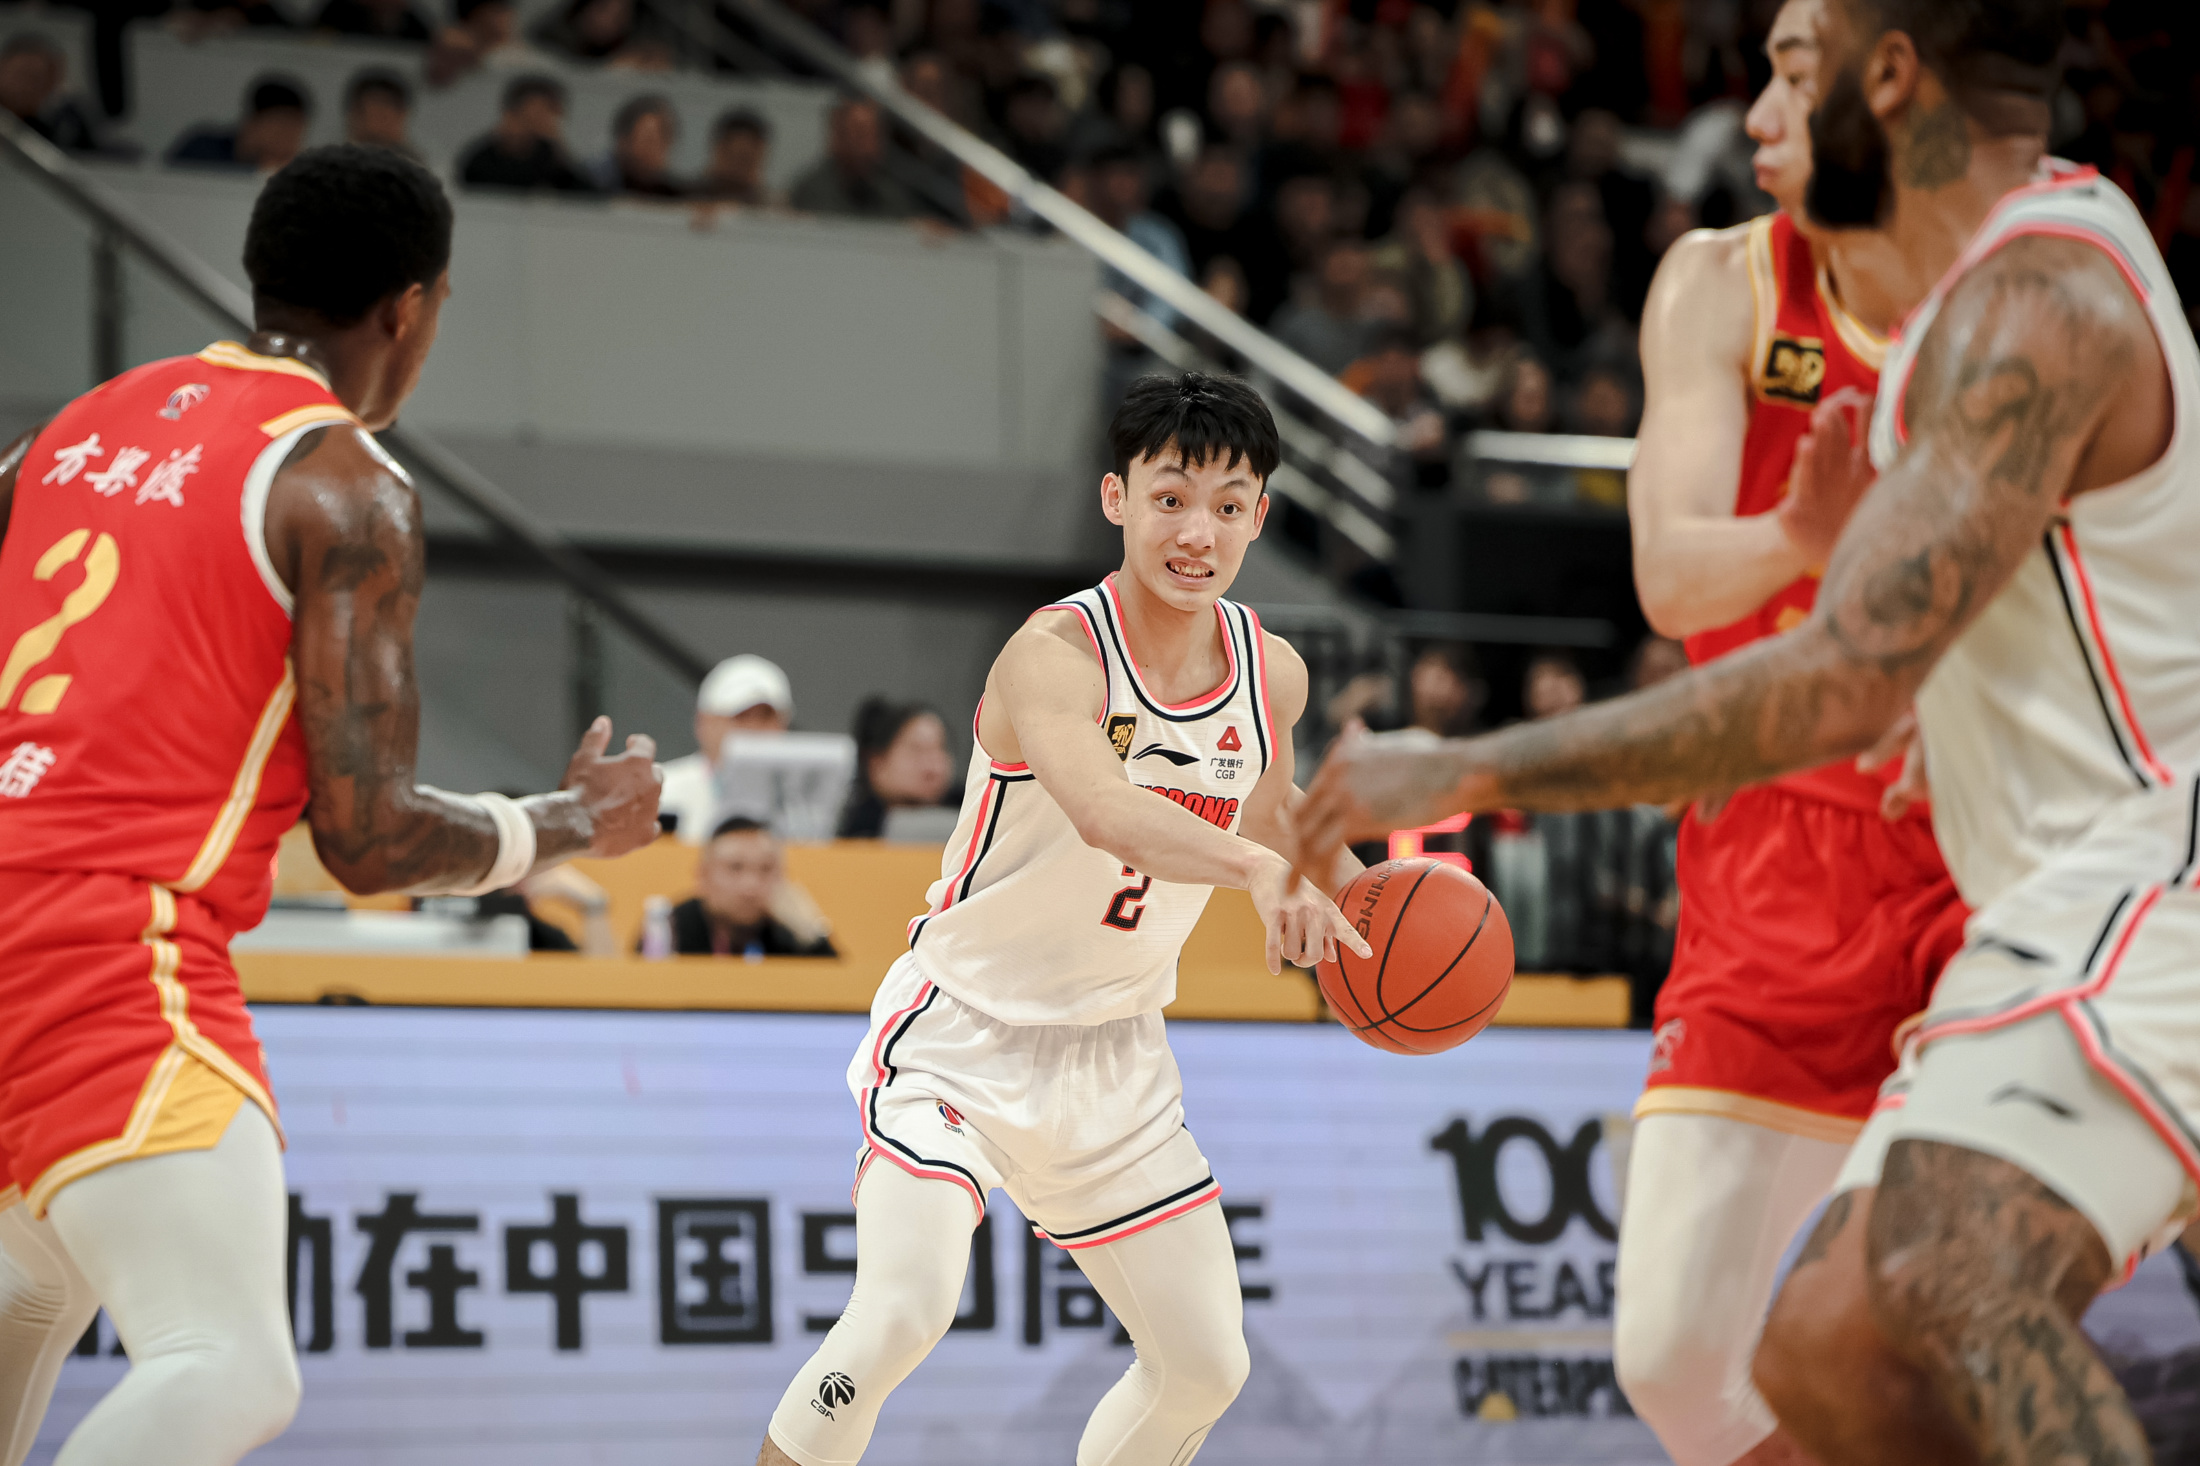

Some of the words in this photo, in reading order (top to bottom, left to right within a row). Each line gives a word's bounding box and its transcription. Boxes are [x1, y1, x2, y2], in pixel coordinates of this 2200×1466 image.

[0, 528, 120, 714] 2
[1210, 757, 1244, 769] 广发银行
[1215, 769, 1236, 780] CGB
[1101, 864, 1152, 932] 2
[811, 1399, 835, 1422] CBA
